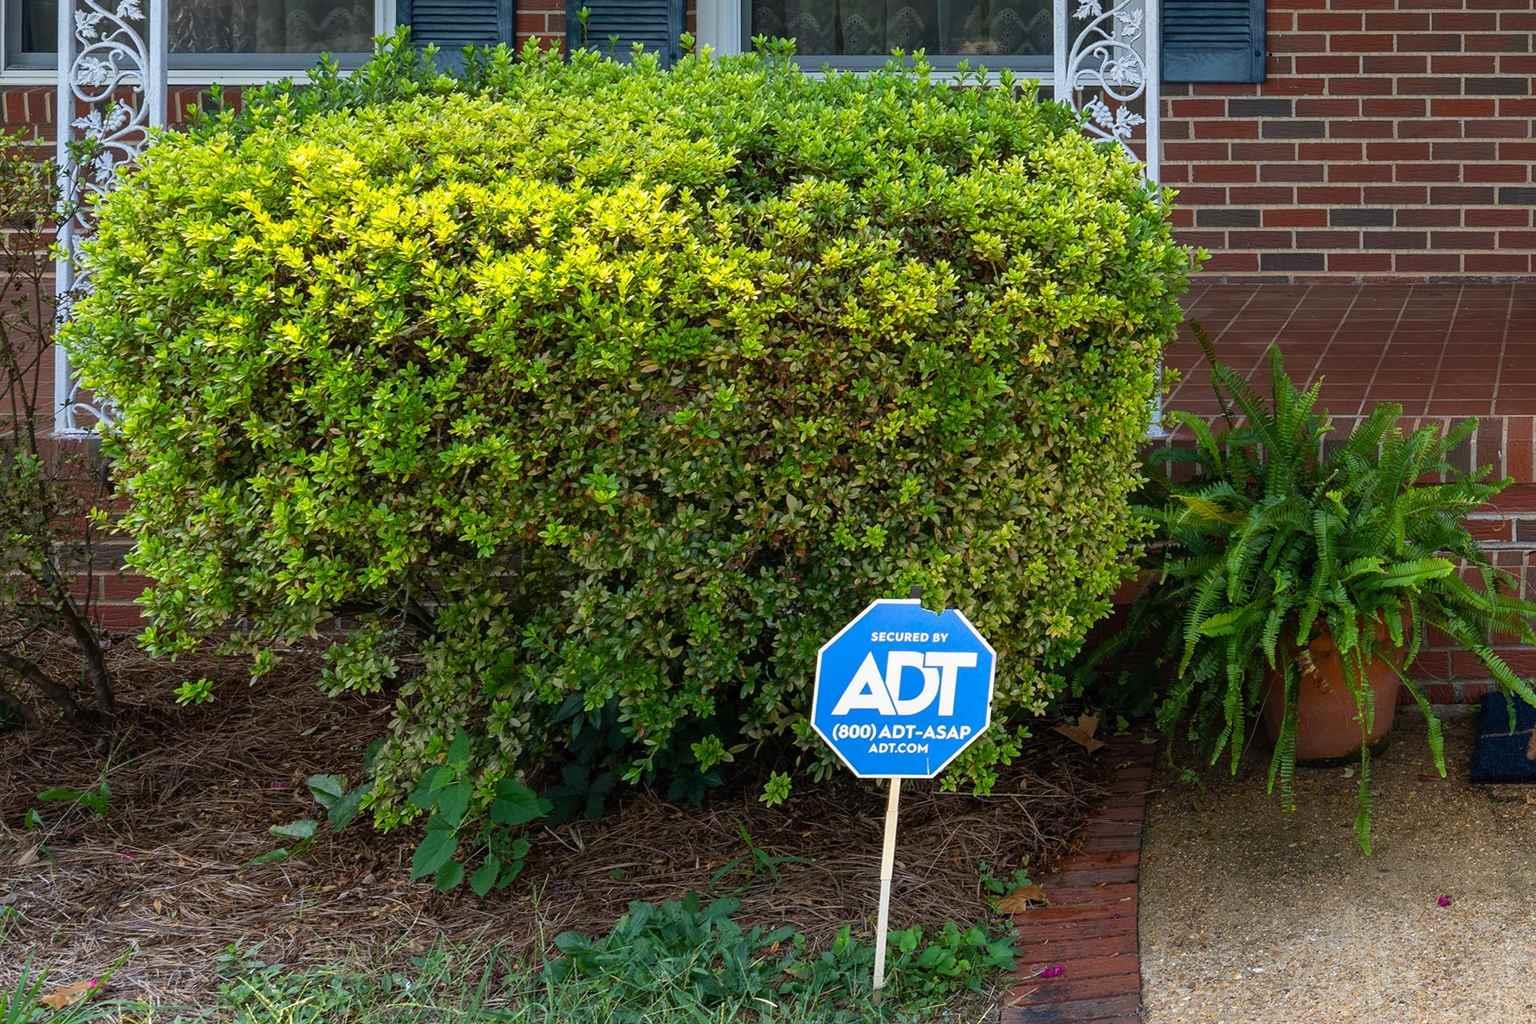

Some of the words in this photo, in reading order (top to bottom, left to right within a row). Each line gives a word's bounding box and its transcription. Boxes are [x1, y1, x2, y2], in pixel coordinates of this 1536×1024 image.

[871, 632, 929, 643] SECURED
[932, 632, 949, 643] BY
[831, 650, 978, 716] ADT
[832, 724, 877, 741] (800)
[879, 725, 972, 740] ADT-ASAP
[868, 743, 929, 754] ADT.COM
